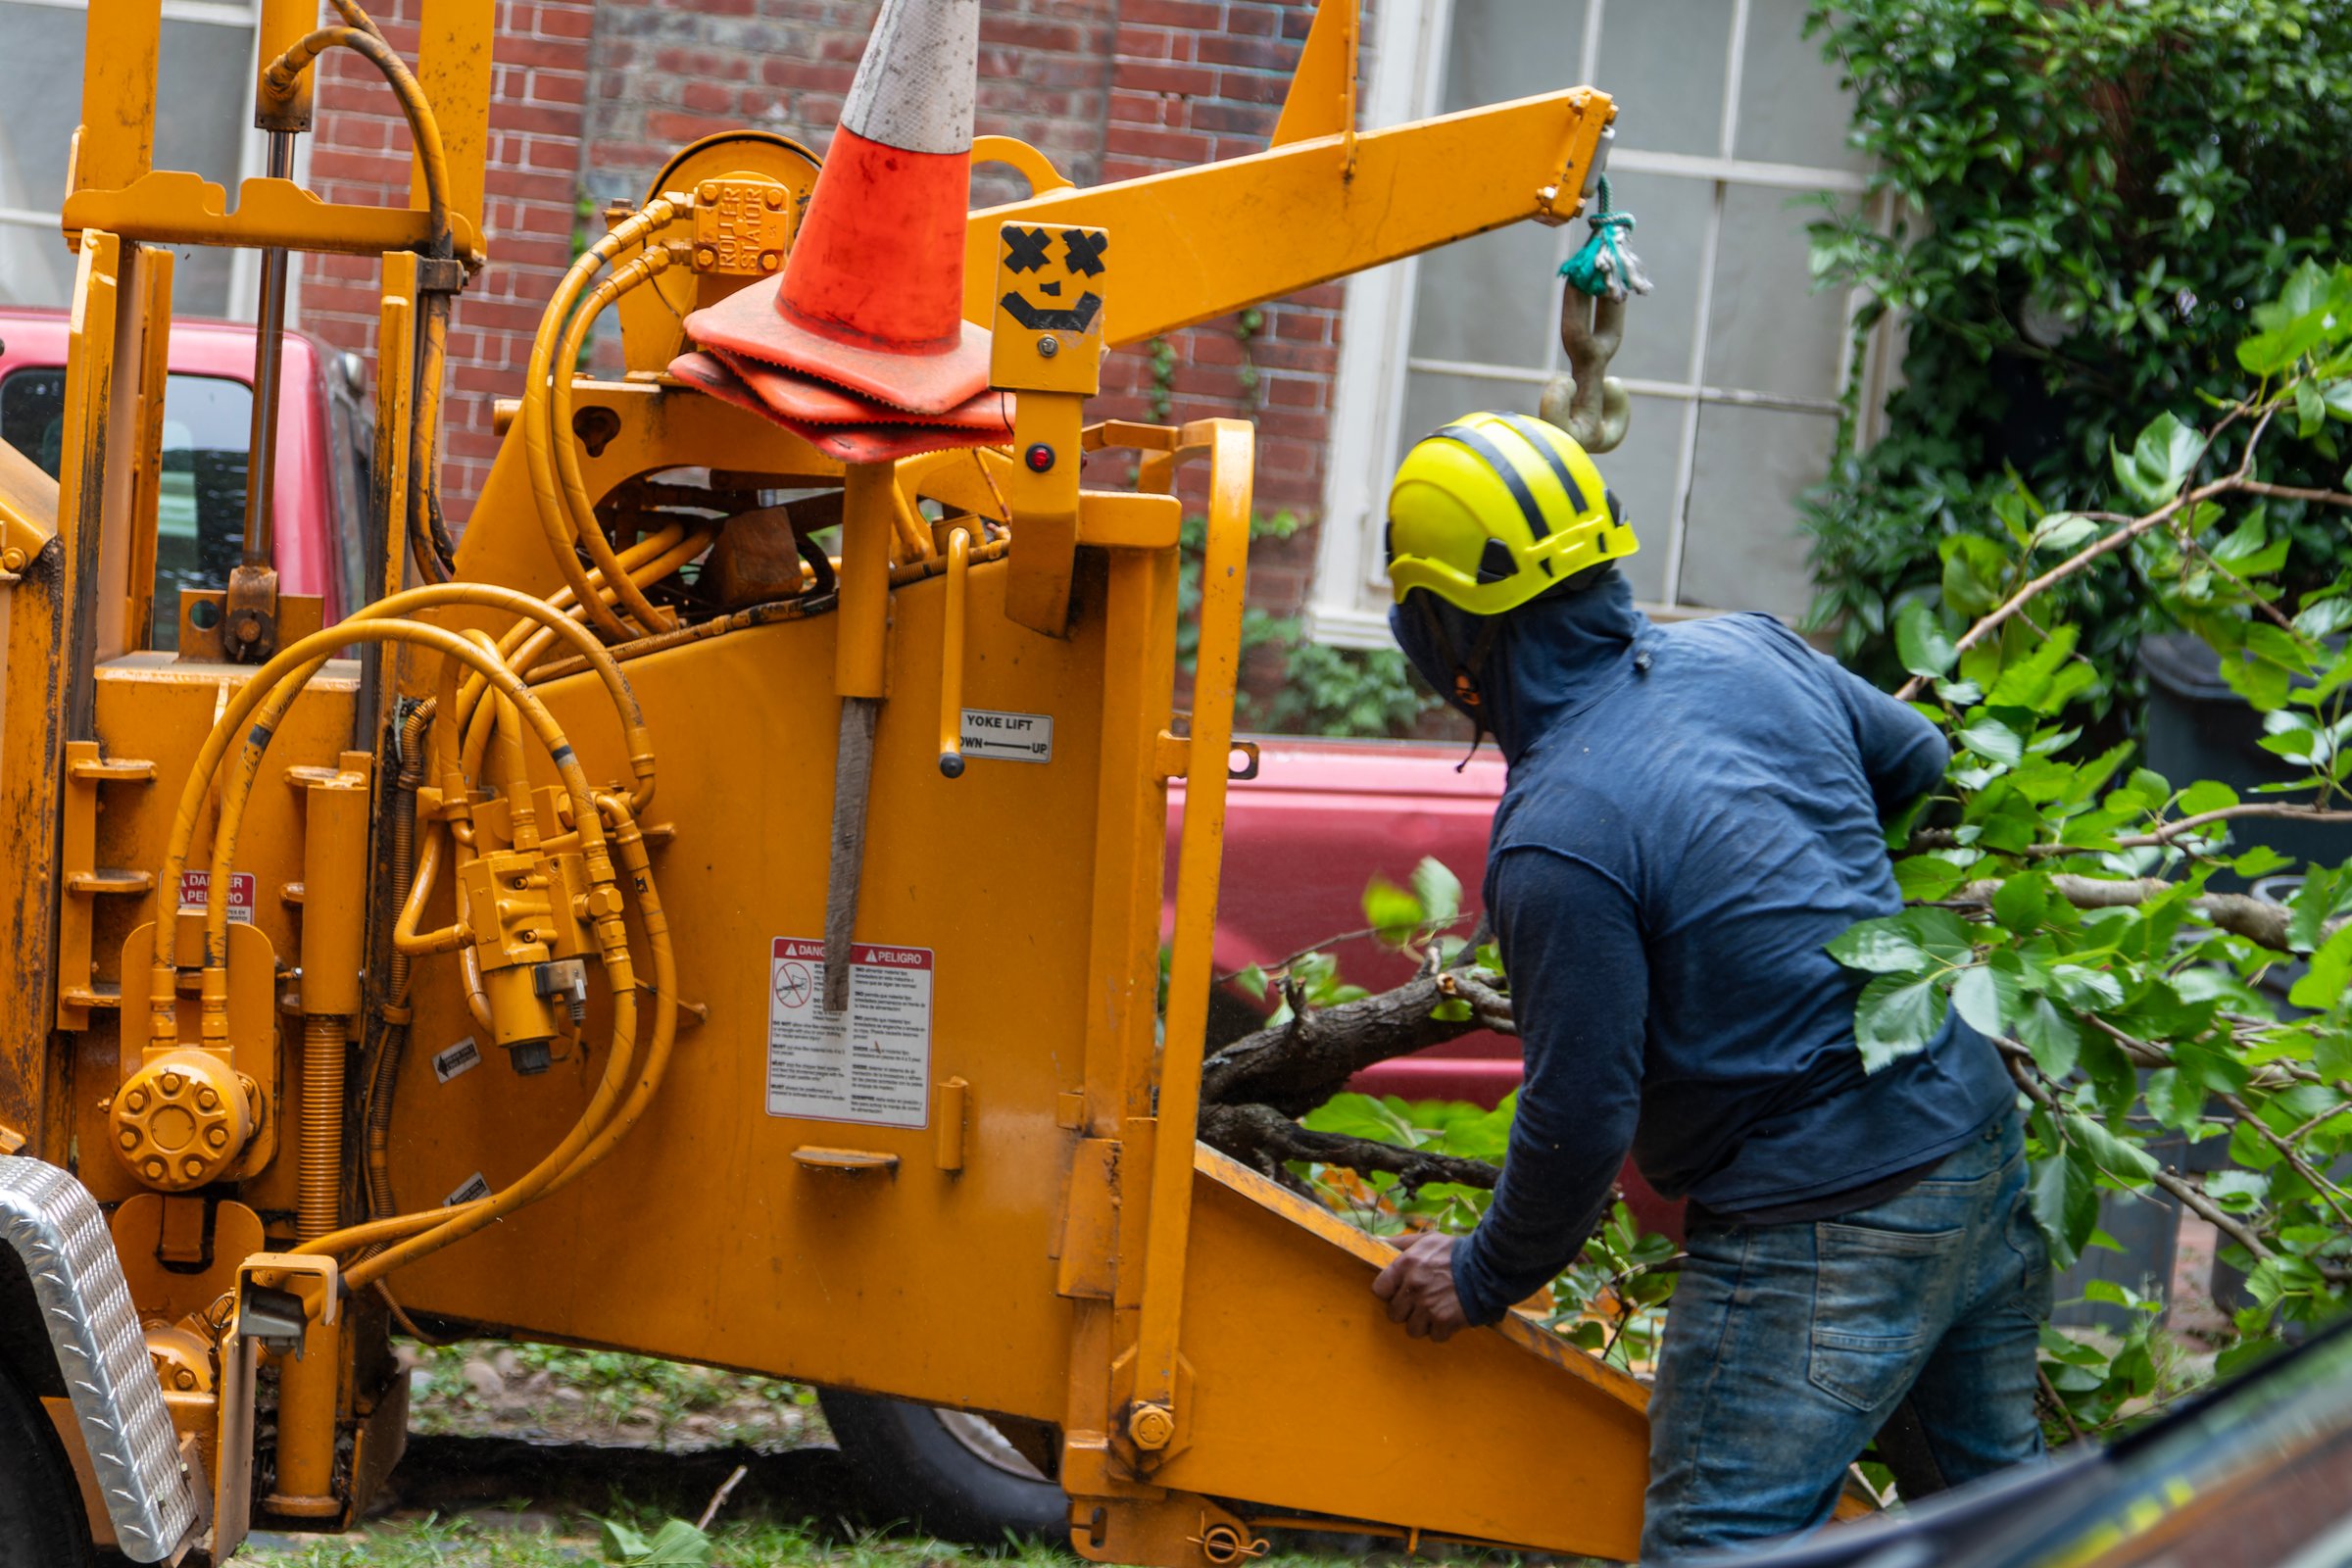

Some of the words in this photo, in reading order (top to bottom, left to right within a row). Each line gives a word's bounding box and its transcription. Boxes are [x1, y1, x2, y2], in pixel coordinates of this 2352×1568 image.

[967, 715, 1003, 728] YOKE
[1005, 718, 1033, 730] LIFT
[1032, 743, 1048, 754] UP
[878, 953, 922, 964] PELIGRO
